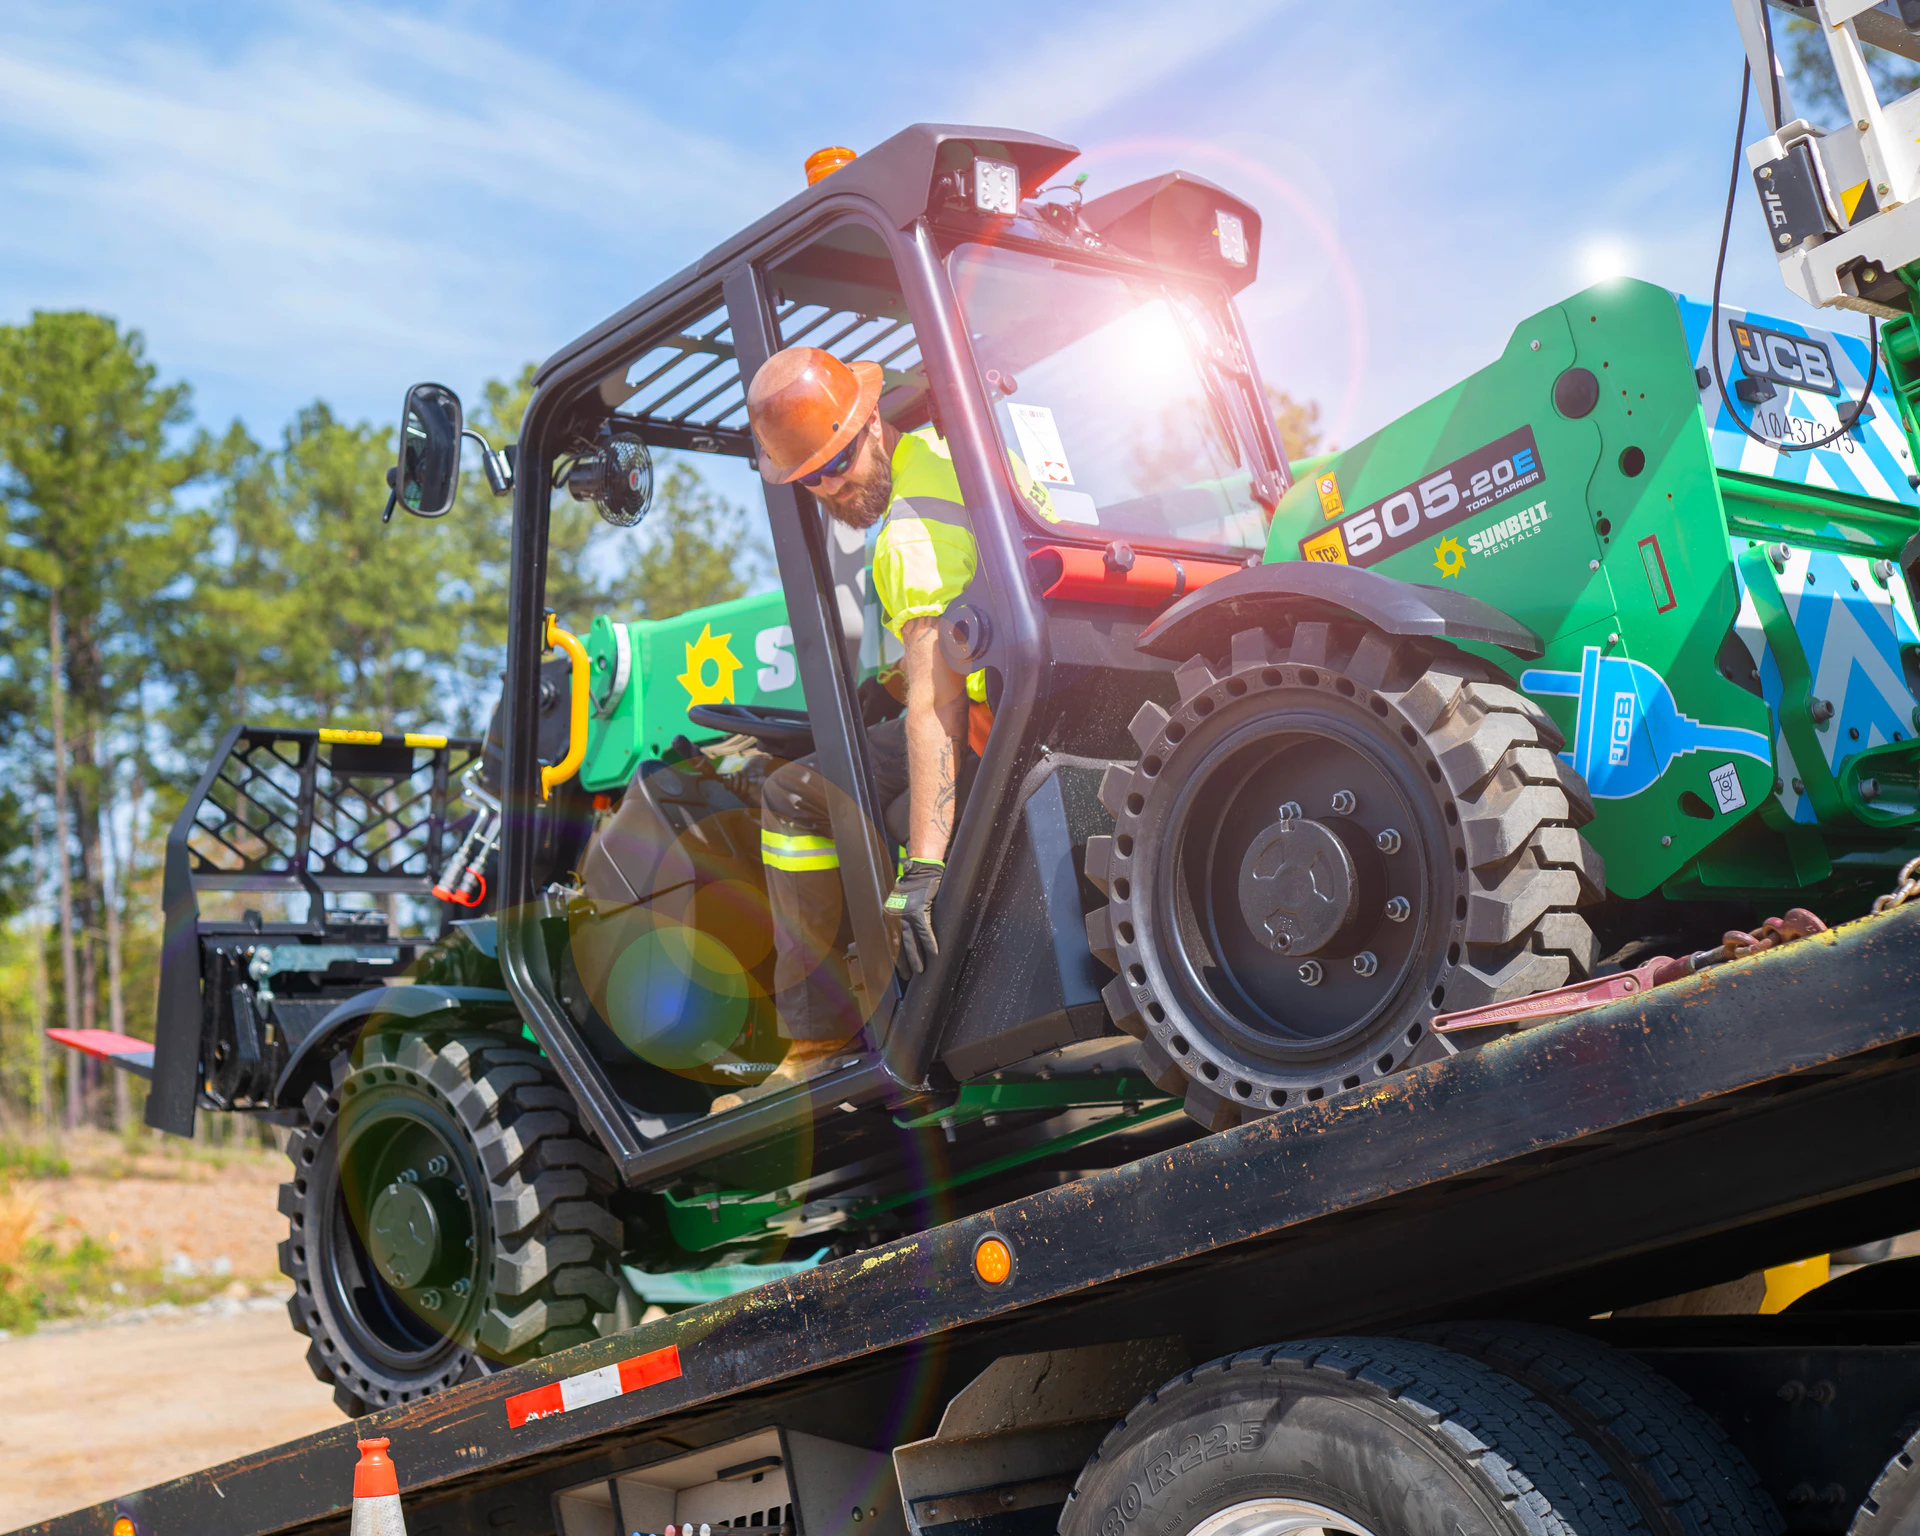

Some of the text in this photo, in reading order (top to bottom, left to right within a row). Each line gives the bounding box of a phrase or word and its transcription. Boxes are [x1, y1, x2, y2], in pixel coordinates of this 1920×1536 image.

[1764, 190, 1788, 229] JLG
[1742, 331, 1834, 388] JCB
[1466, 471, 1540, 513] TOOL CARRIER
[1467, 500, 1548, 555] SUNBELT
[1483, 525, 1542, 558] RENTALS
[1612, 697, 1632, 762] JCB
